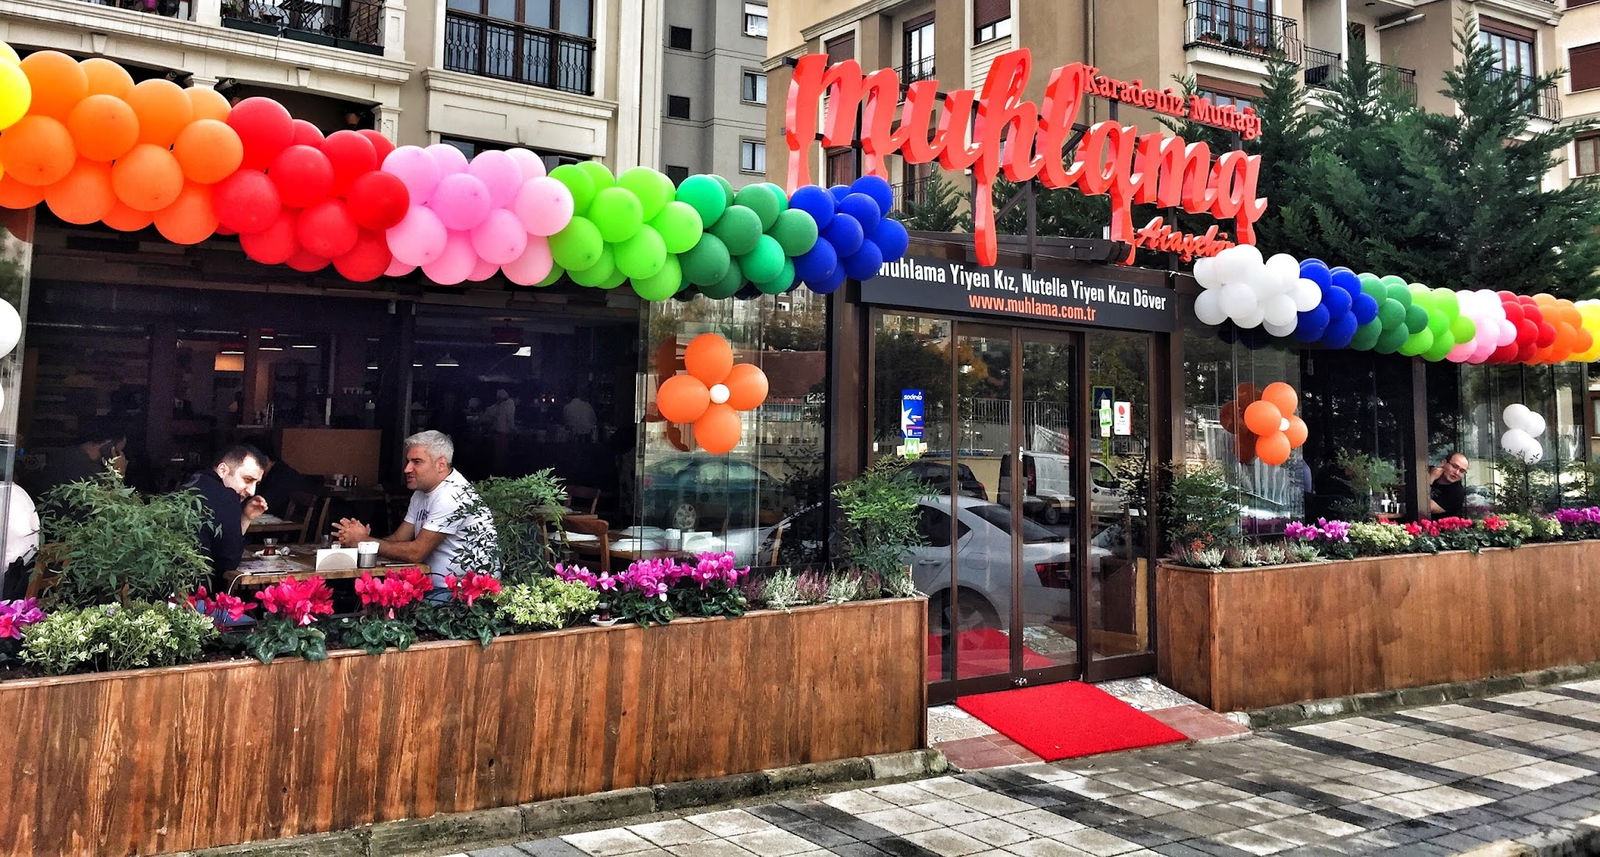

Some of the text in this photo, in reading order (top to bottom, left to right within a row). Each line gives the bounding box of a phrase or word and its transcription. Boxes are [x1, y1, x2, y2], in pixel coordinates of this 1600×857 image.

[1083, 65, 1262, 140] Karadeniz Mutfağı
[949, 263, 990, 291] Yiyen
[994, 269, 1019, 293] Kız,
[1022, 273, 1067, 298] Nutella
[1071, 282, 1105, 305] Yiyen
[1108, 285, 1131, 306] Kızı
[1133, 288, 1167, 311] Döver
[968, 294, 1097, 321] www.muhlama.com.tr
